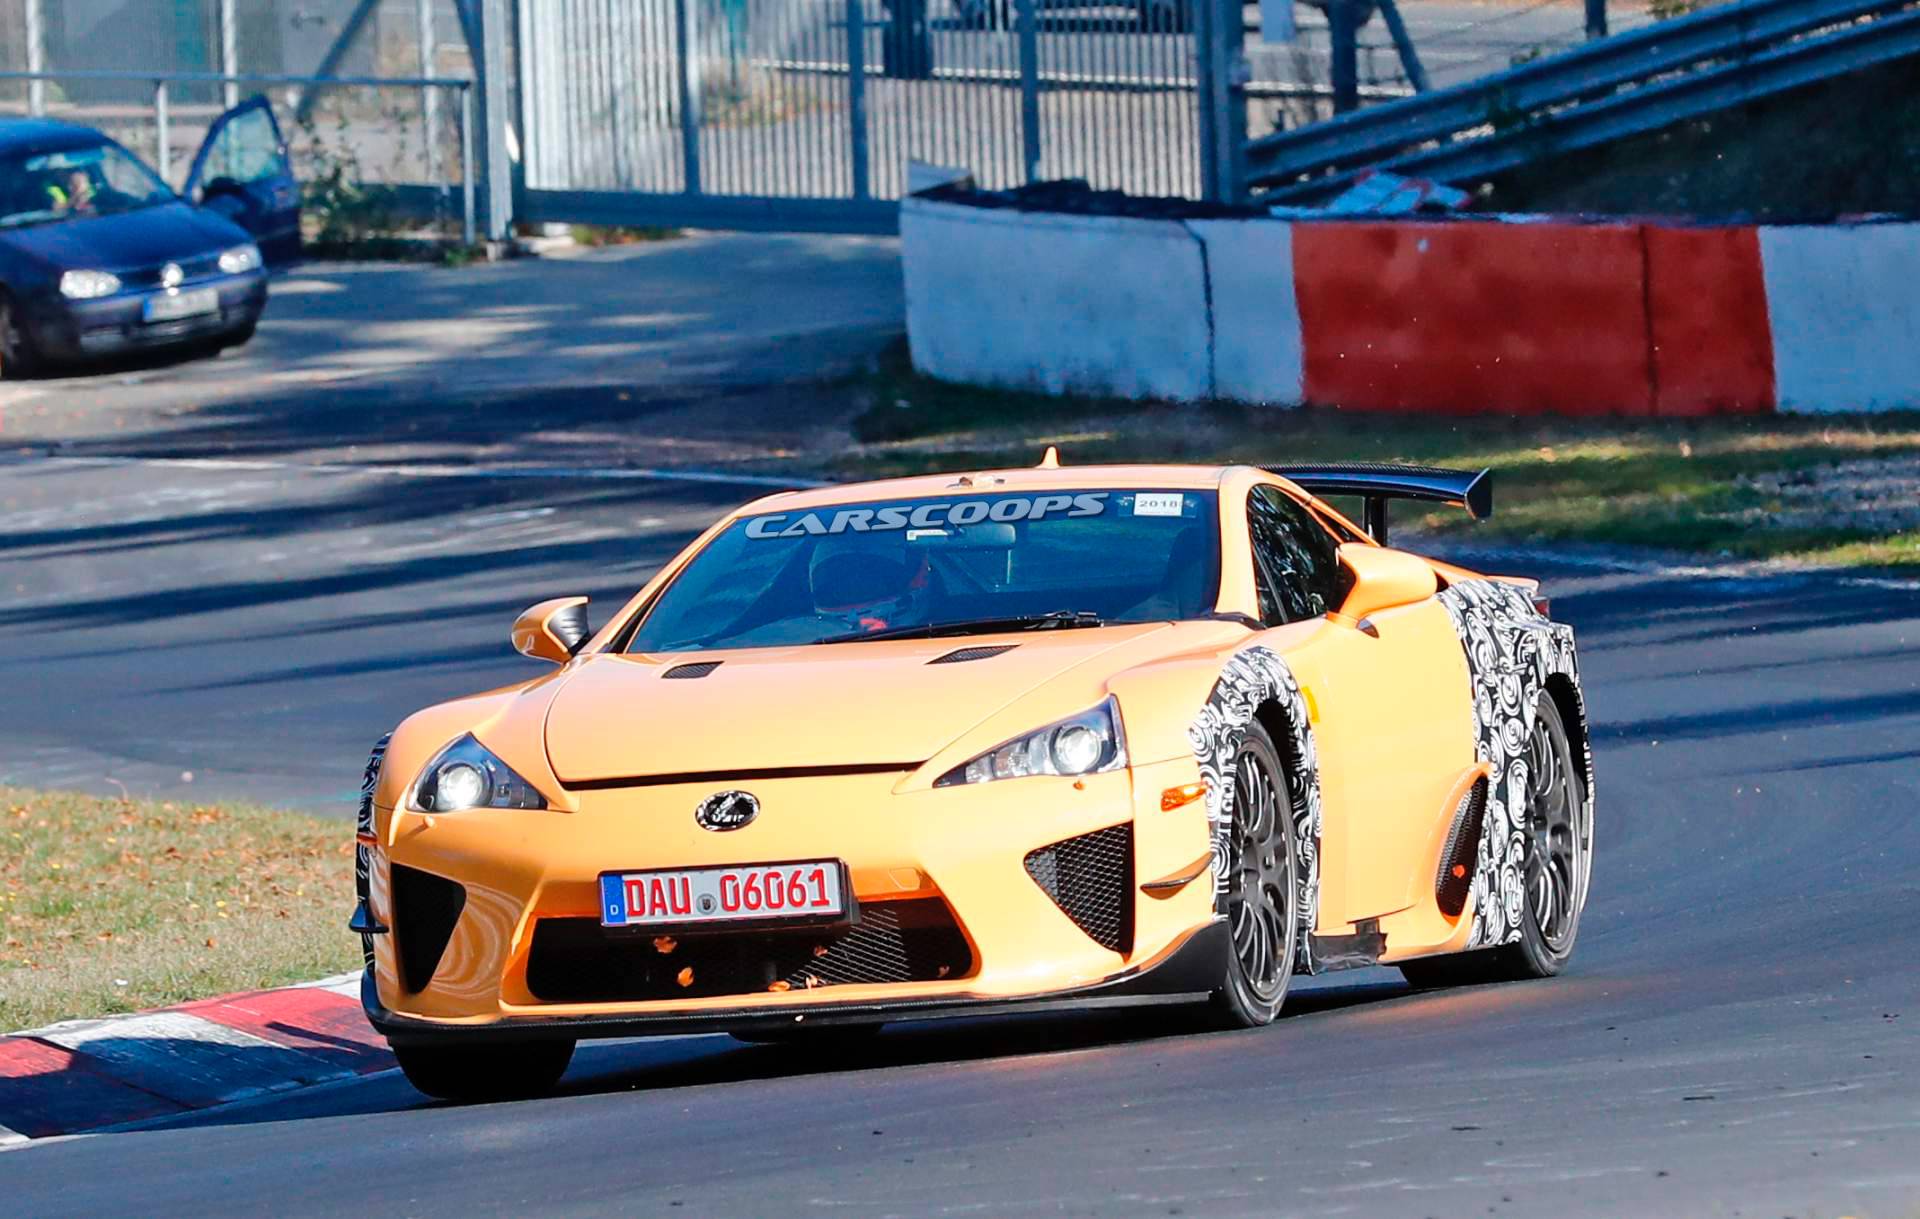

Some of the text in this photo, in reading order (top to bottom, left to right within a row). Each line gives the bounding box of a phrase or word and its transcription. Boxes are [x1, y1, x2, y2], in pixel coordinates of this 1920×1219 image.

[1139, 500, 1178, 508] 2018
[624, 868, 831, 917] DAU 06061
[610, 905, 619, 915] D
